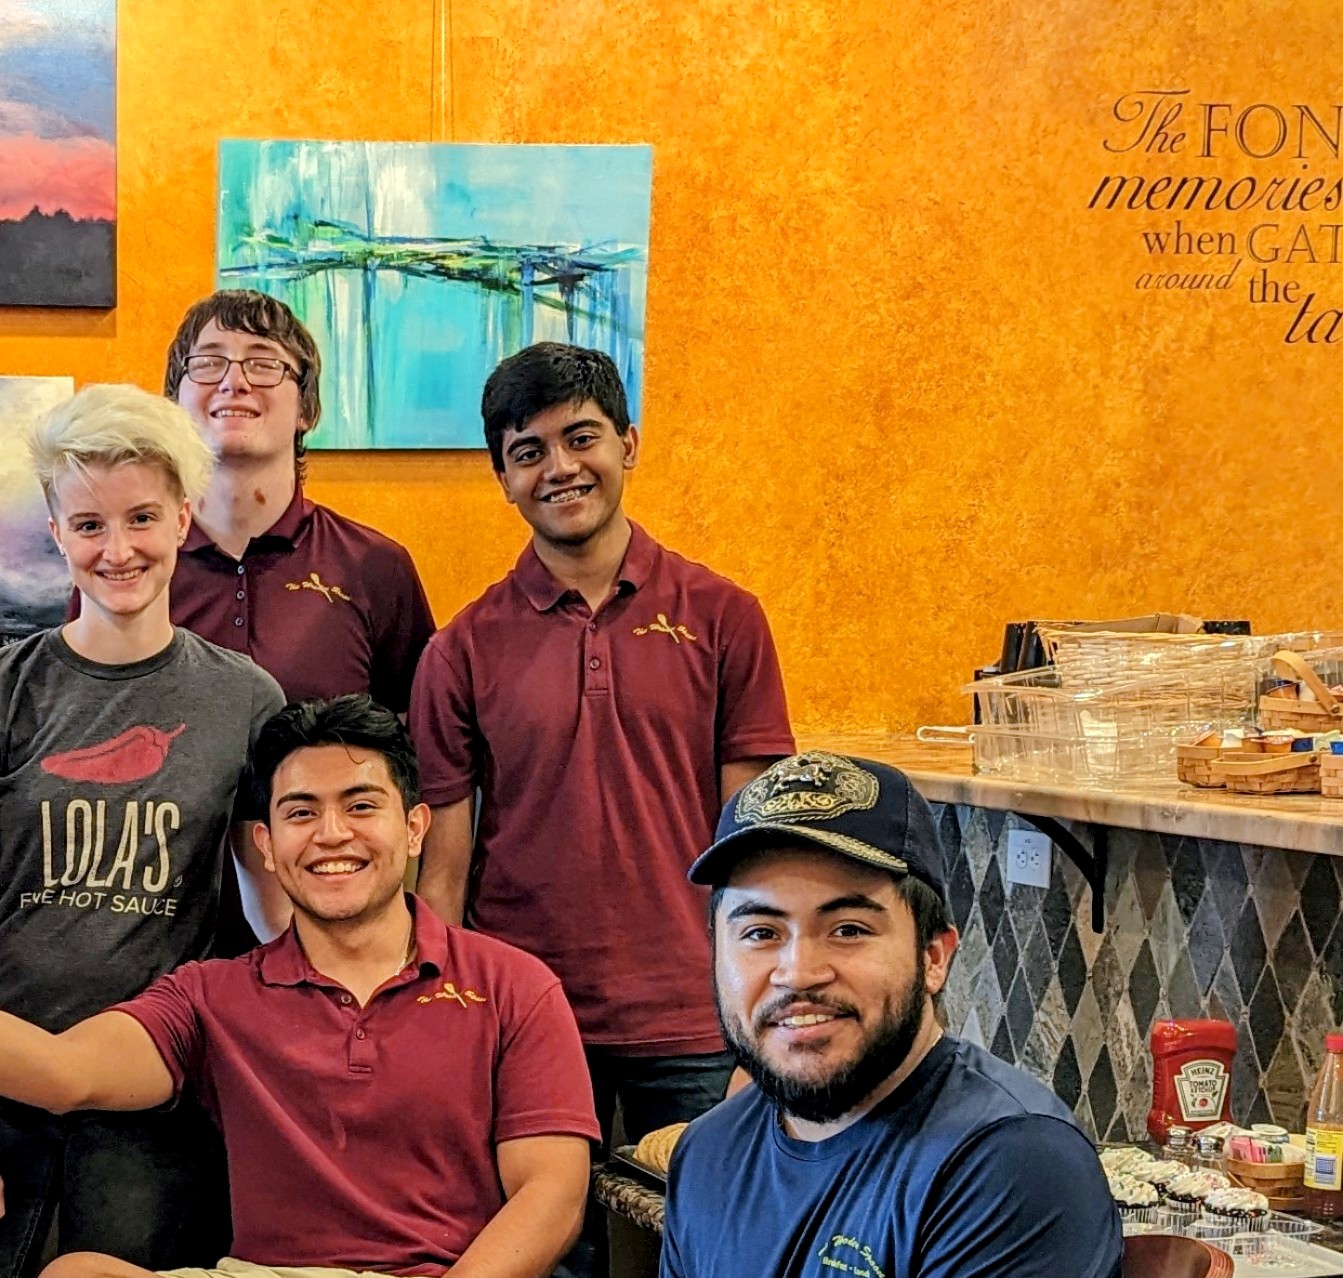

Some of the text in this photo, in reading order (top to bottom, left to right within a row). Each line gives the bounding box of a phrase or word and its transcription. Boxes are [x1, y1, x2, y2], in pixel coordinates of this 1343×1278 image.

[1102, 89, 1343, 159] The FON
[1087, 163, 1343, 211] memories
[1142, 220, 1343, 264] when GAT
[1135, 258, 1301, 304] around the
[41, 800, 180, 893] LOLA'S
[58, 889, 107, 910] HOT
[111, 894, 178, 917] SAUCE
[1190, 1066, 1215, 1076] HEINZ
